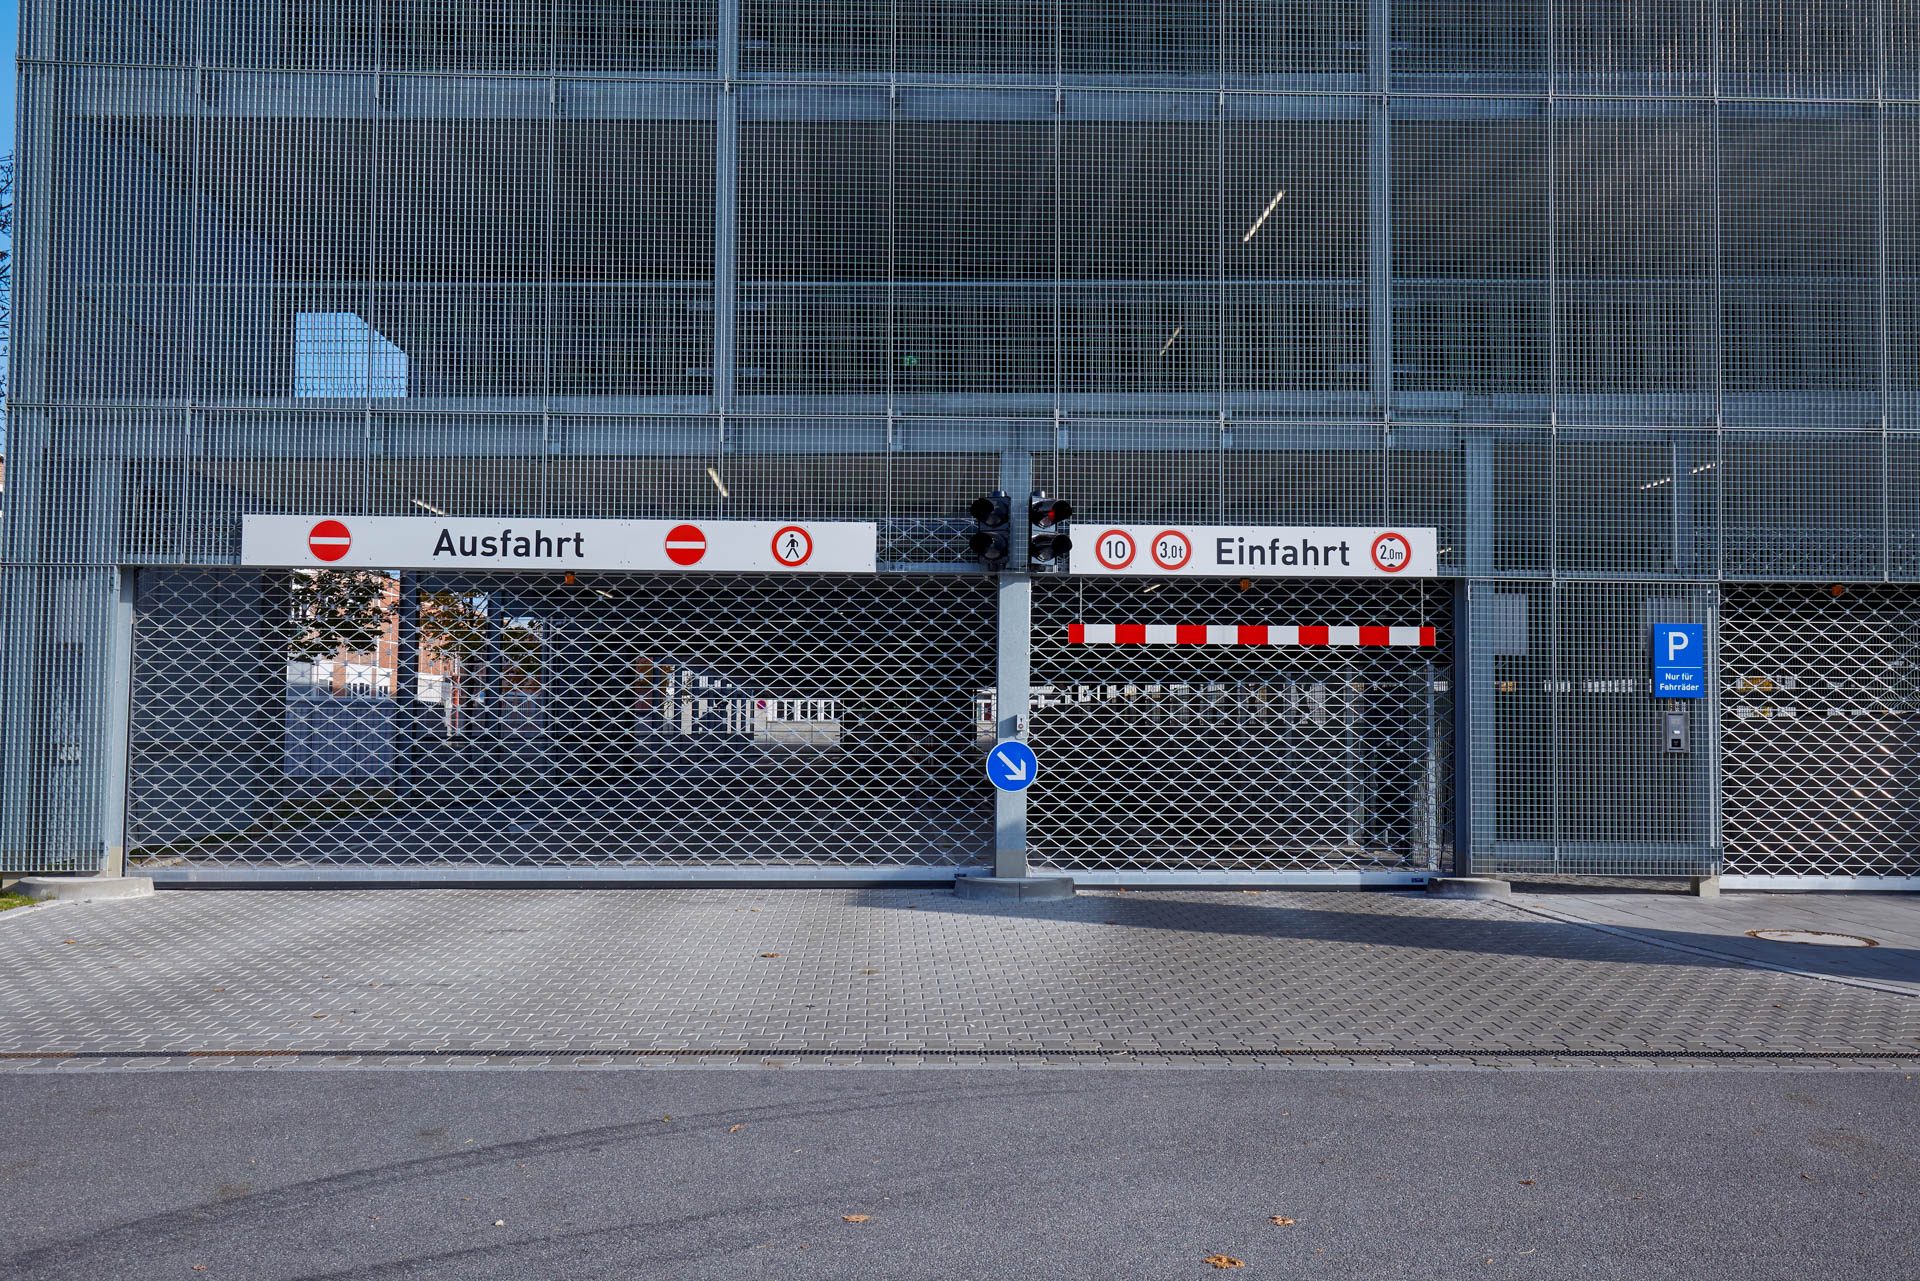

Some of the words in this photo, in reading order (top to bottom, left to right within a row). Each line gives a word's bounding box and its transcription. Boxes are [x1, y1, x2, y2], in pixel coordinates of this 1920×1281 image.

[433, 528, 584, 557] Ausfahrt
[1106, 540, 1126, 559] 10
[1217, 537, 1350, 566] Einfahrt
[1668, 631, 1689, 661] P
[1659, 683, 1700, 691] Fahrräder
[1665, 672, 1680, 681] Nur
[1681, 672, 1694, 681] für
